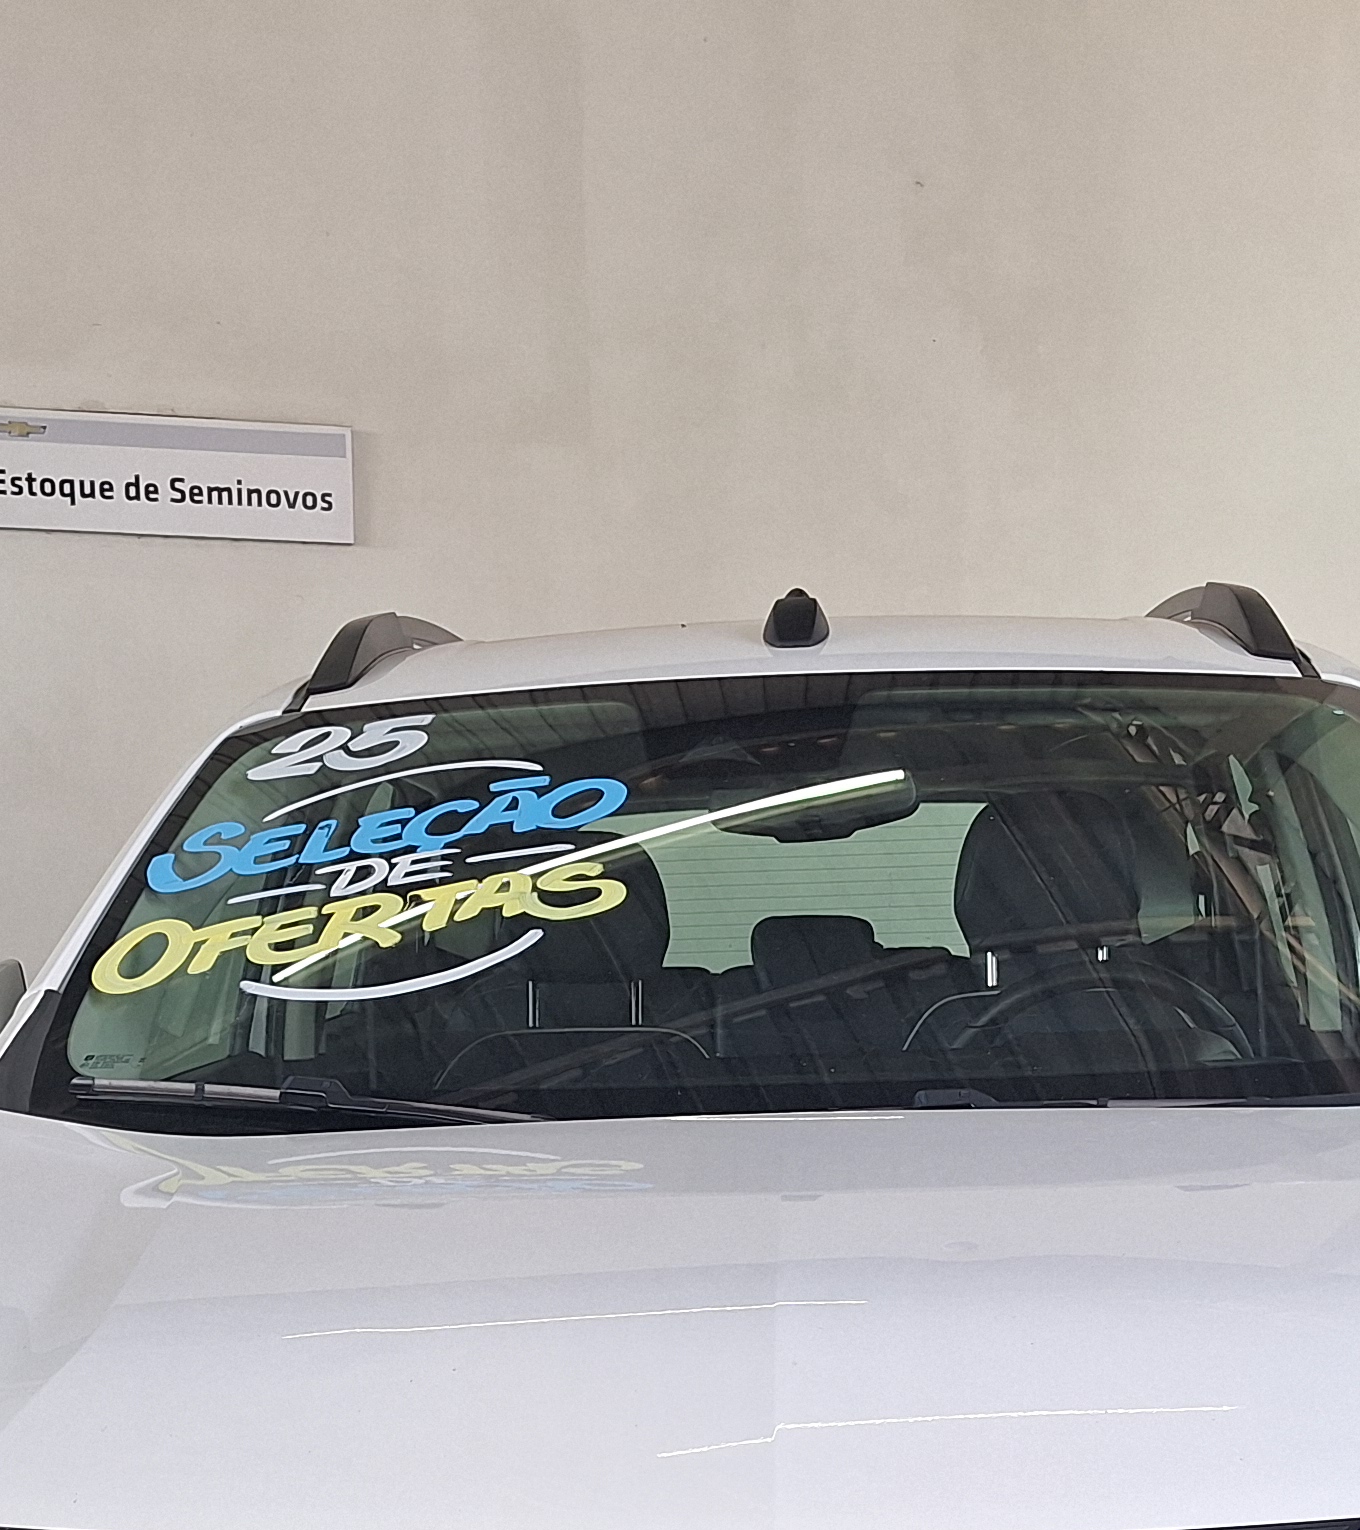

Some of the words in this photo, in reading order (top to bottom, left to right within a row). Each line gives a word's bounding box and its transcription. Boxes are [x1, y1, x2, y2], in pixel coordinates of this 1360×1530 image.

[124, 474, 160, 503] de
[169, 477, 334, 512] Seminovos
[246, 714, 436, 781] 25
[146, 776, 628, 893] SELEÇÃO
[315, 848, 462, 897] DE
[92, 861, 628, 994] OFERTAS
